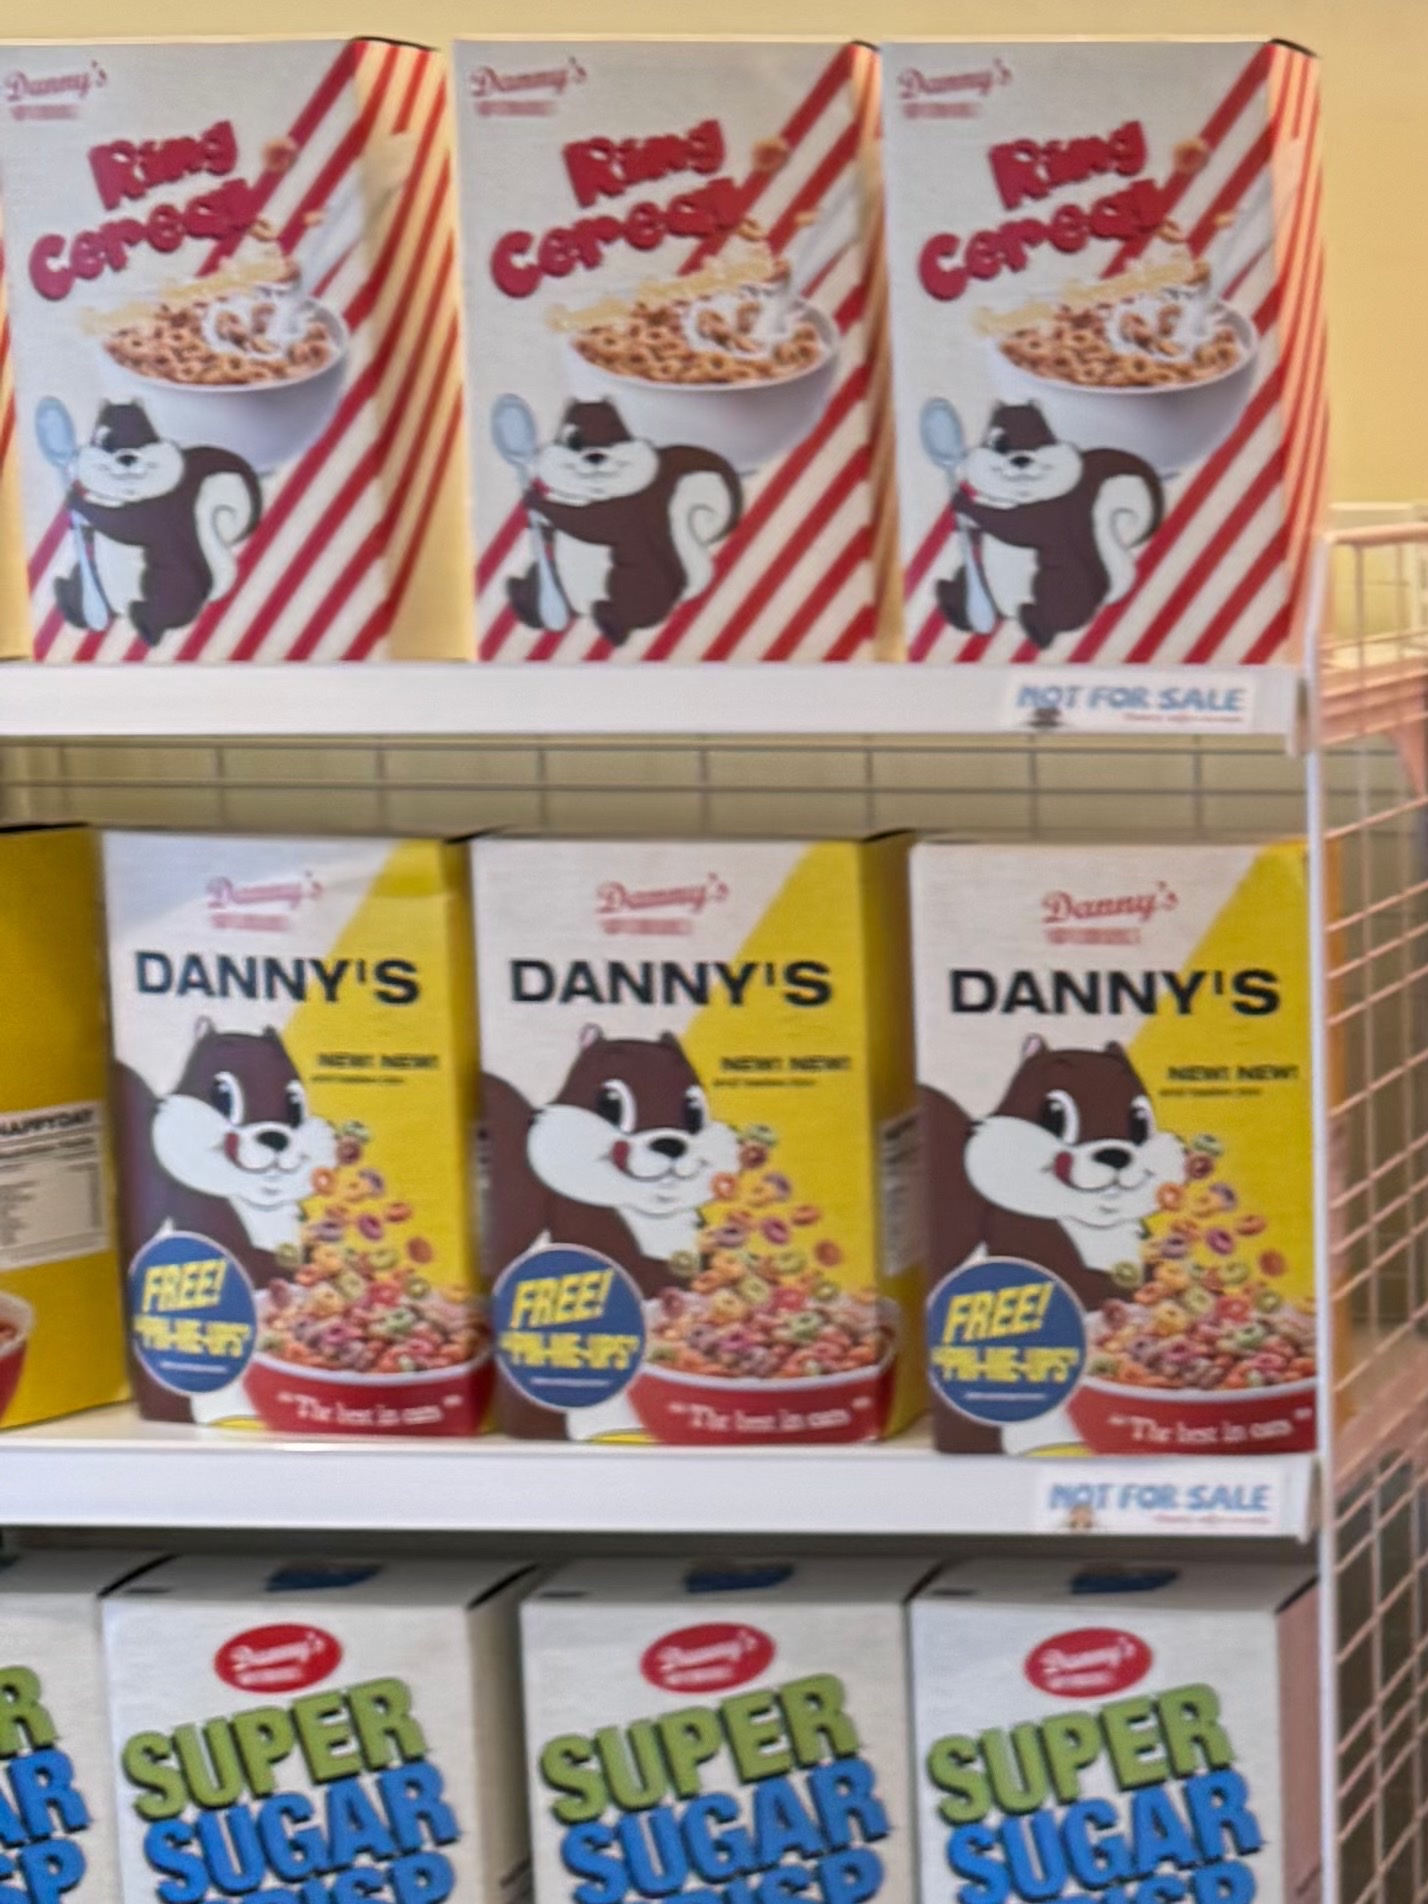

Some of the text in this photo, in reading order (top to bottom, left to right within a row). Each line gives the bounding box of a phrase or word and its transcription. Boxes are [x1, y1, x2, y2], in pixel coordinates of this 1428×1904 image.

[1157, 686, 1247, 712] SALE
[1040, 880, 1178, 923] Danny's
[135, 951, 421, 1006] DANNY'S
[509, 959, 832, 1007] DANNY'S
[949, 969, 1281, 1016] DANNY'S
[143, 1259, 226, 1313] FREE!
[511, 1266, 617, 1329] FREE!
[943, 1280, 1056, 1344] FREE!
[1186, 1484, 1273, 1512] SALE
[121, 1677, 427, 1823] SUPER
[540, 1673, 860, 1825] SUPER
[926, 1683, 1235, 1826] SUPER
